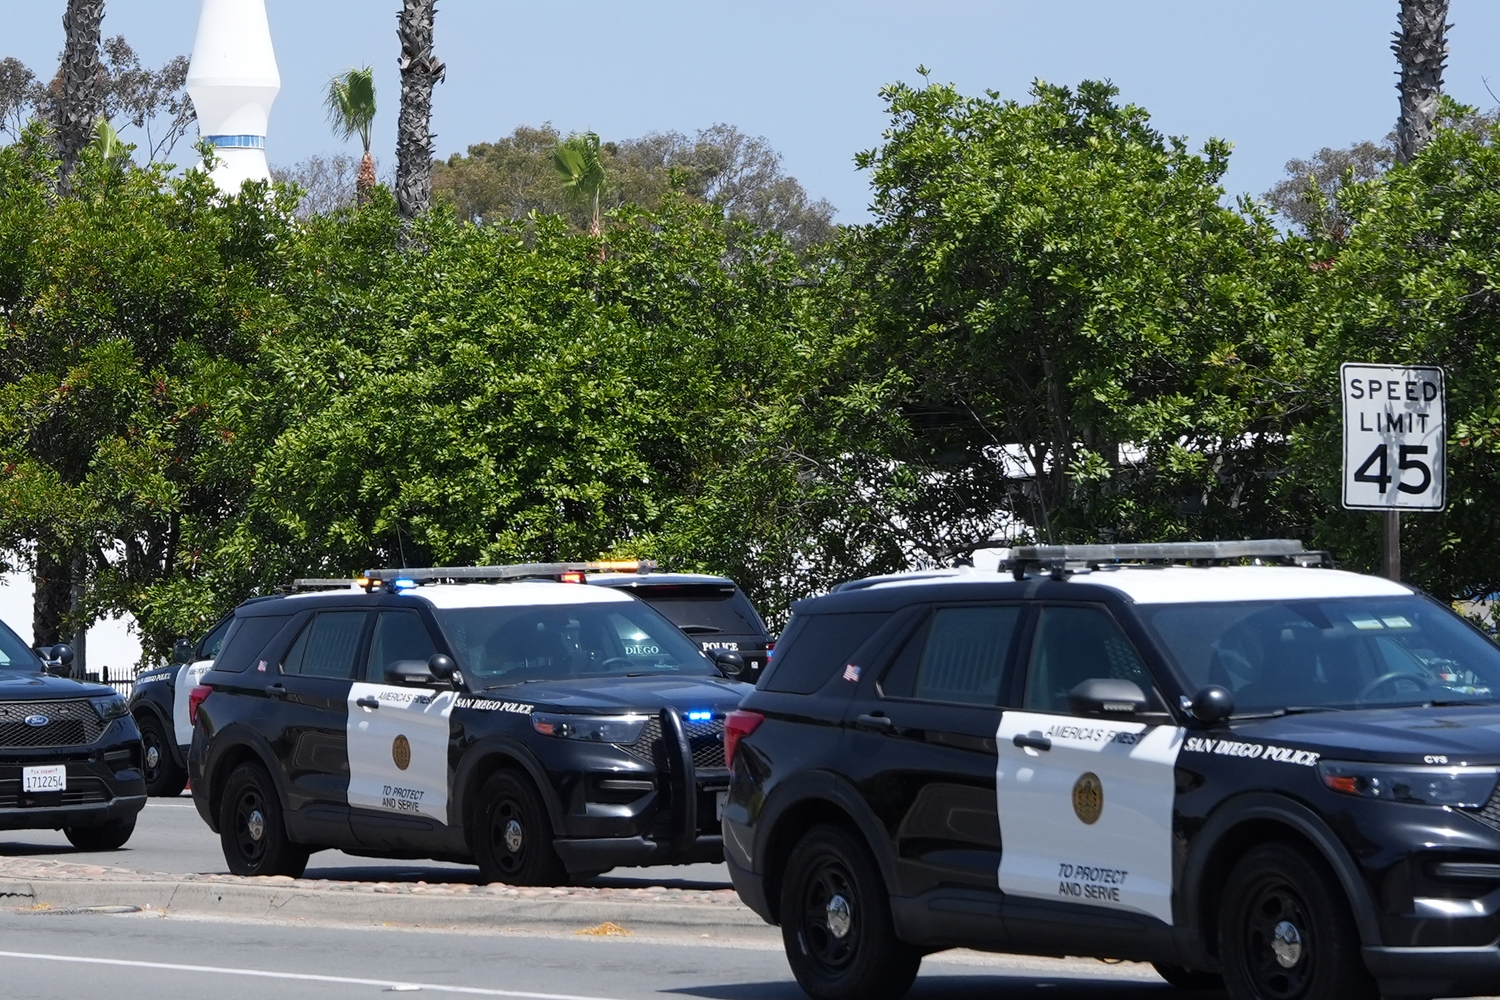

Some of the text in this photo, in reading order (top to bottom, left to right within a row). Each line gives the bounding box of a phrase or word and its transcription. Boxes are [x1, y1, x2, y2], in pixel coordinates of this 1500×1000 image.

[1350, 379, 1437, 402] SPEED
[1360, 412, 1429, 433] LIMIT
[1354, 444, 1431, 495] 45
[625, 642, 739, 655] DIEGO POLICE
[454, 698, 534, 715] SAN DIEGO POLICE
[1044, 725, 1145, 745] AMERICA'S FINEST
[1184, 737, 1320, 767] SAN DIEGO POLICE
[26, 775, 63, 788] 1712254
[382, 785, 424, 801] TO PROTECT
[382, 797, 420, 812] AND SERVE
[1058, 863, 1128, 885] TO PROTECT
[1059, 881, 1120, 902] AND SERVE
